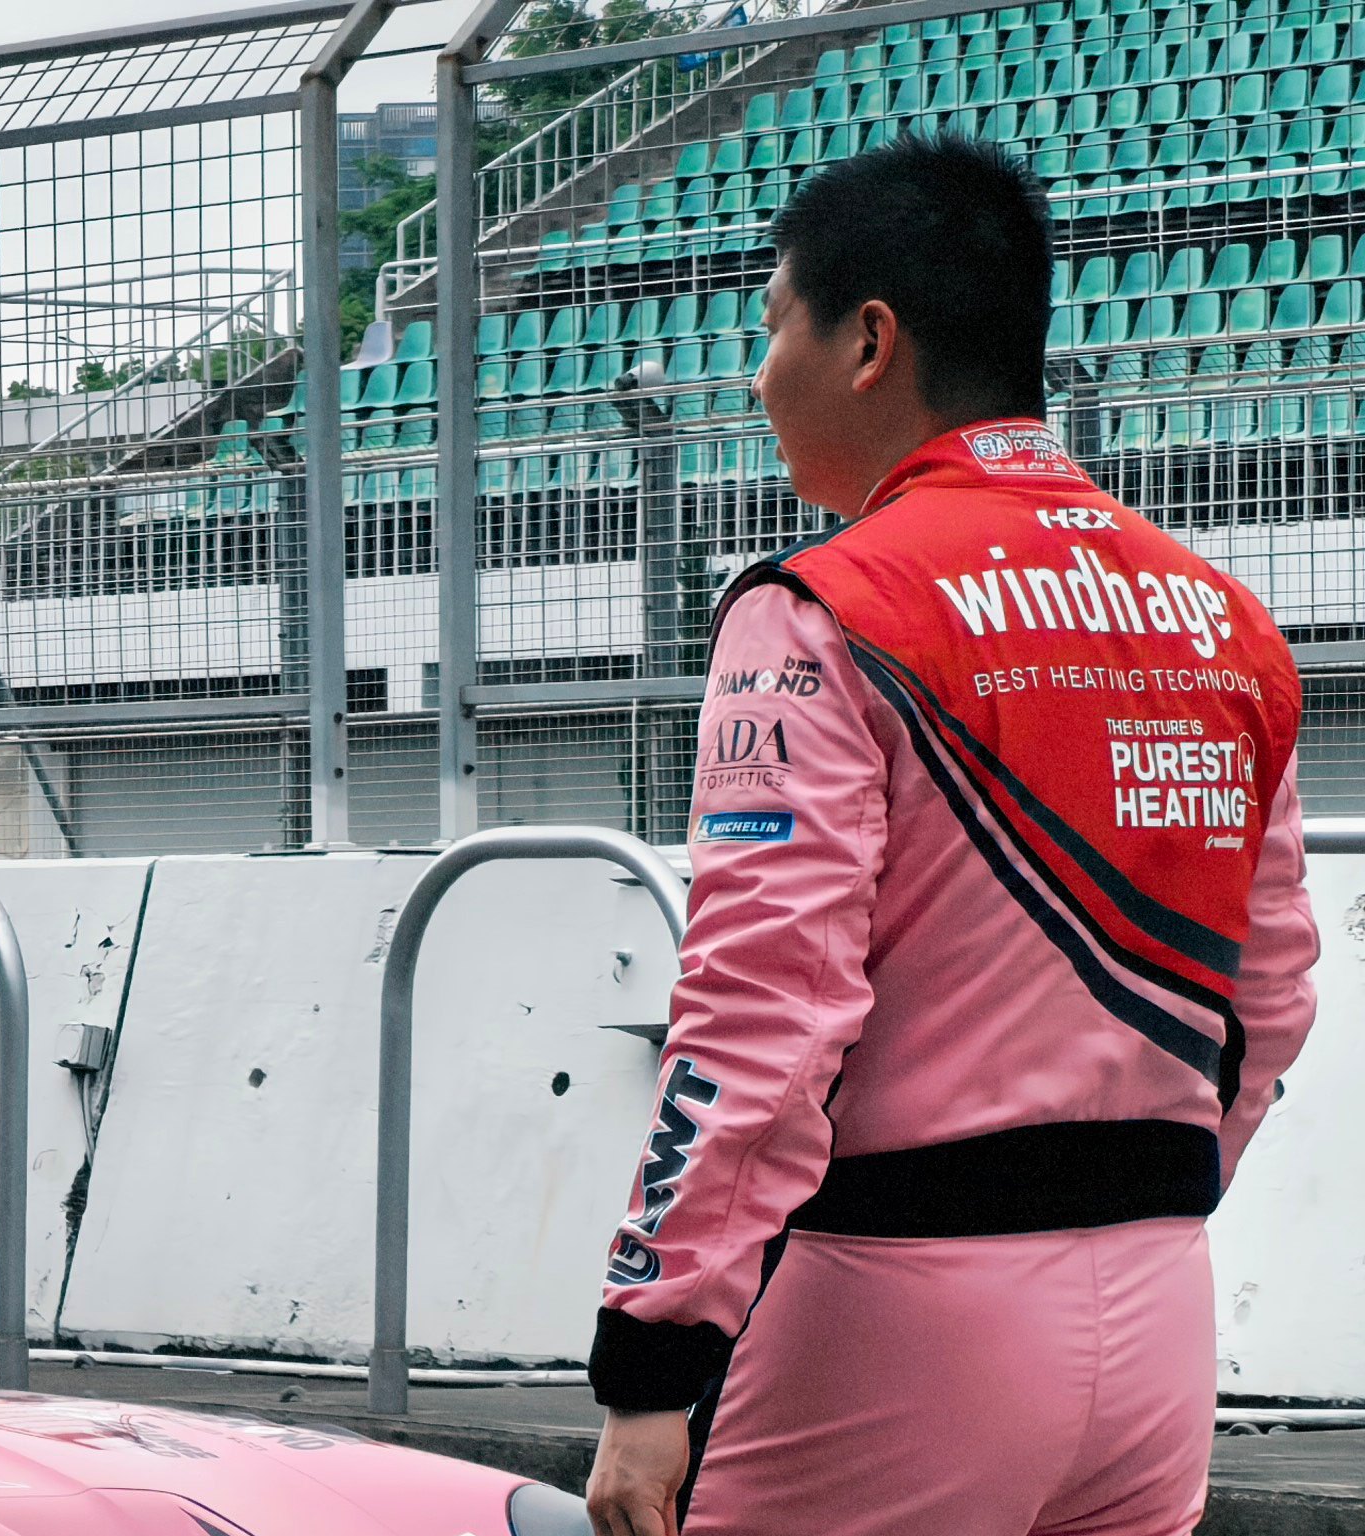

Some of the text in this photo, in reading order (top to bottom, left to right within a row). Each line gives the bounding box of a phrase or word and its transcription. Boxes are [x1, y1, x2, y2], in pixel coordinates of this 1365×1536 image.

[1036, 507, 1121, 530] HRX
[935, 546, 1231, 659] windhage
[974, 665, 1262, 701] BEST HEATING TECHNOLOG
[702, 718, 796, 767] ADA
[1106, 719, 1203, 736] THE FUTURE IS
[1111, 741, 1236, 782] PUREST
[700, 771, 787, 790] COSMETICS
[1115, 787, 1246, 827] HEATING
[711, 821, 780, 834] MICHELIN
